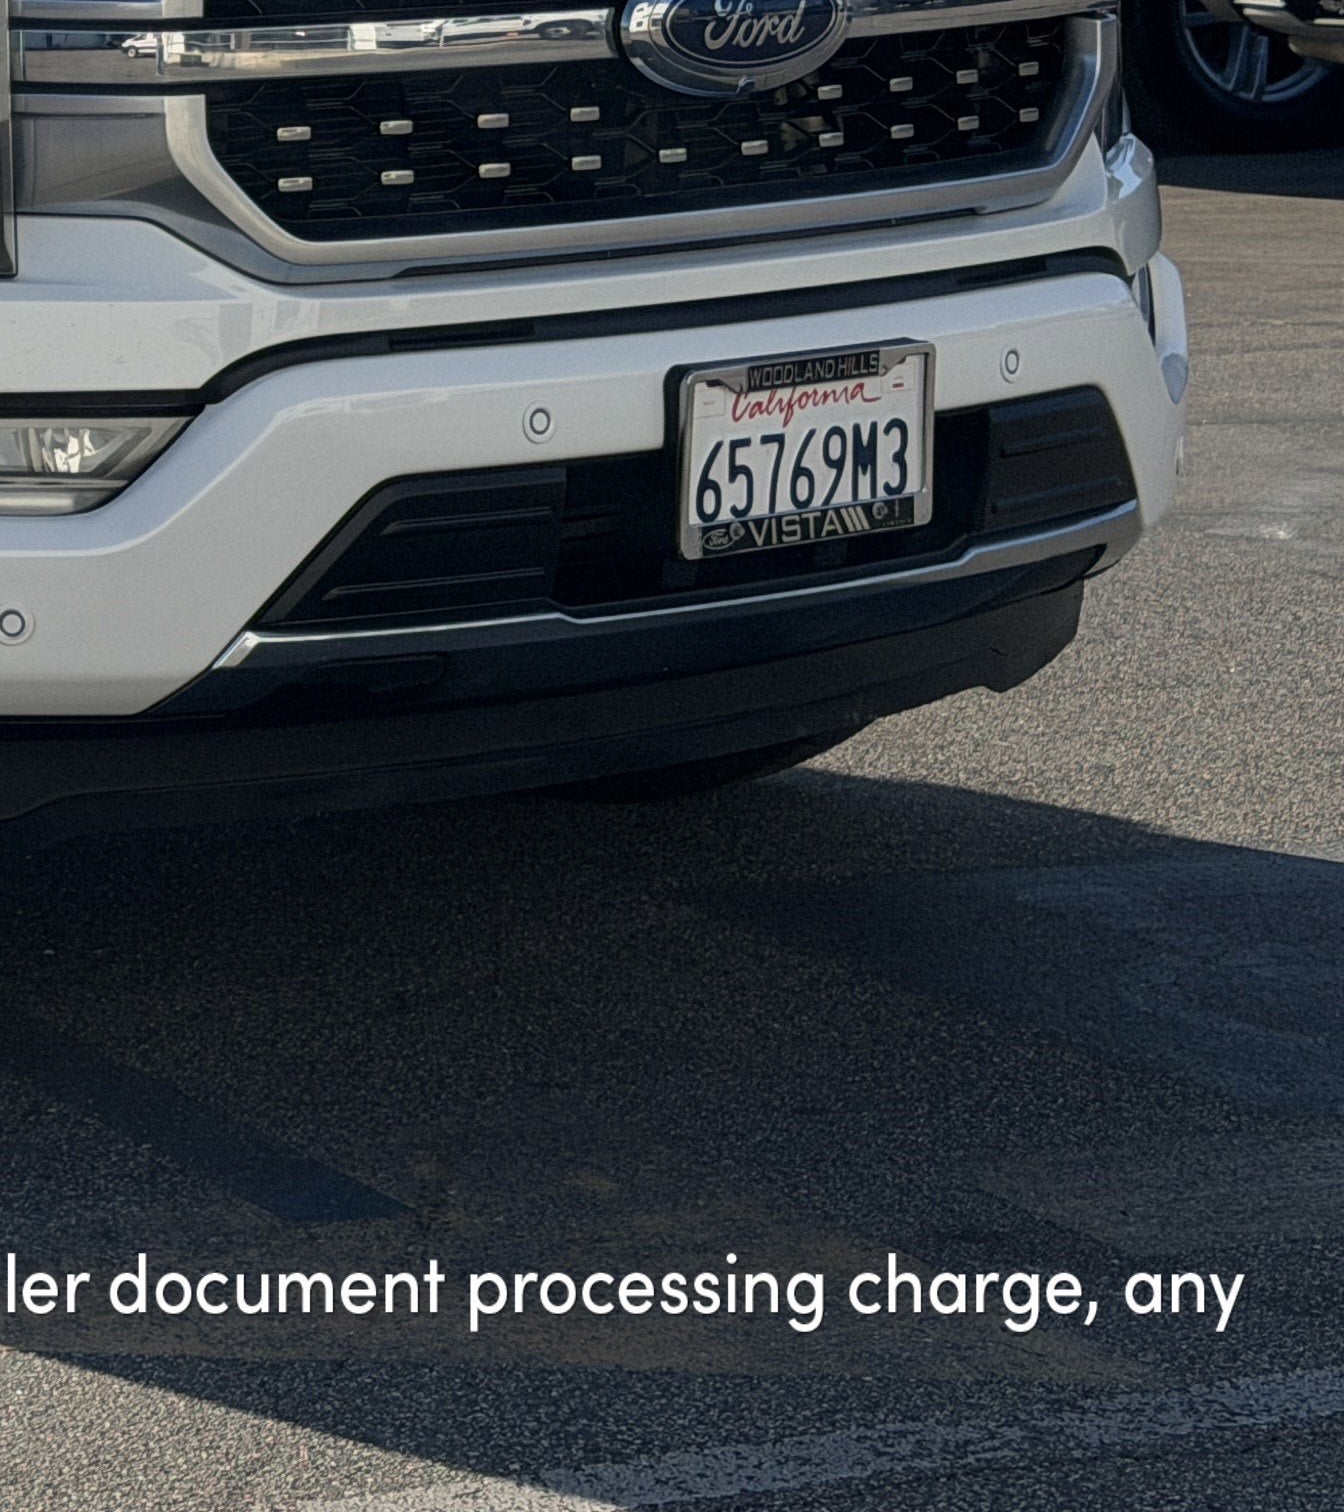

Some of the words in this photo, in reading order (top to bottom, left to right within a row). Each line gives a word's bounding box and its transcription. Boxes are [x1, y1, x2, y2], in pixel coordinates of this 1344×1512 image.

[748, 357, 836, 388] WOODLAND
[837, 352, 880, 376] HILLS
[731, 382, 881, 428] California
[695, 418, 909, 524] 65769M3
[748, 509, 844, 547] VISTA
